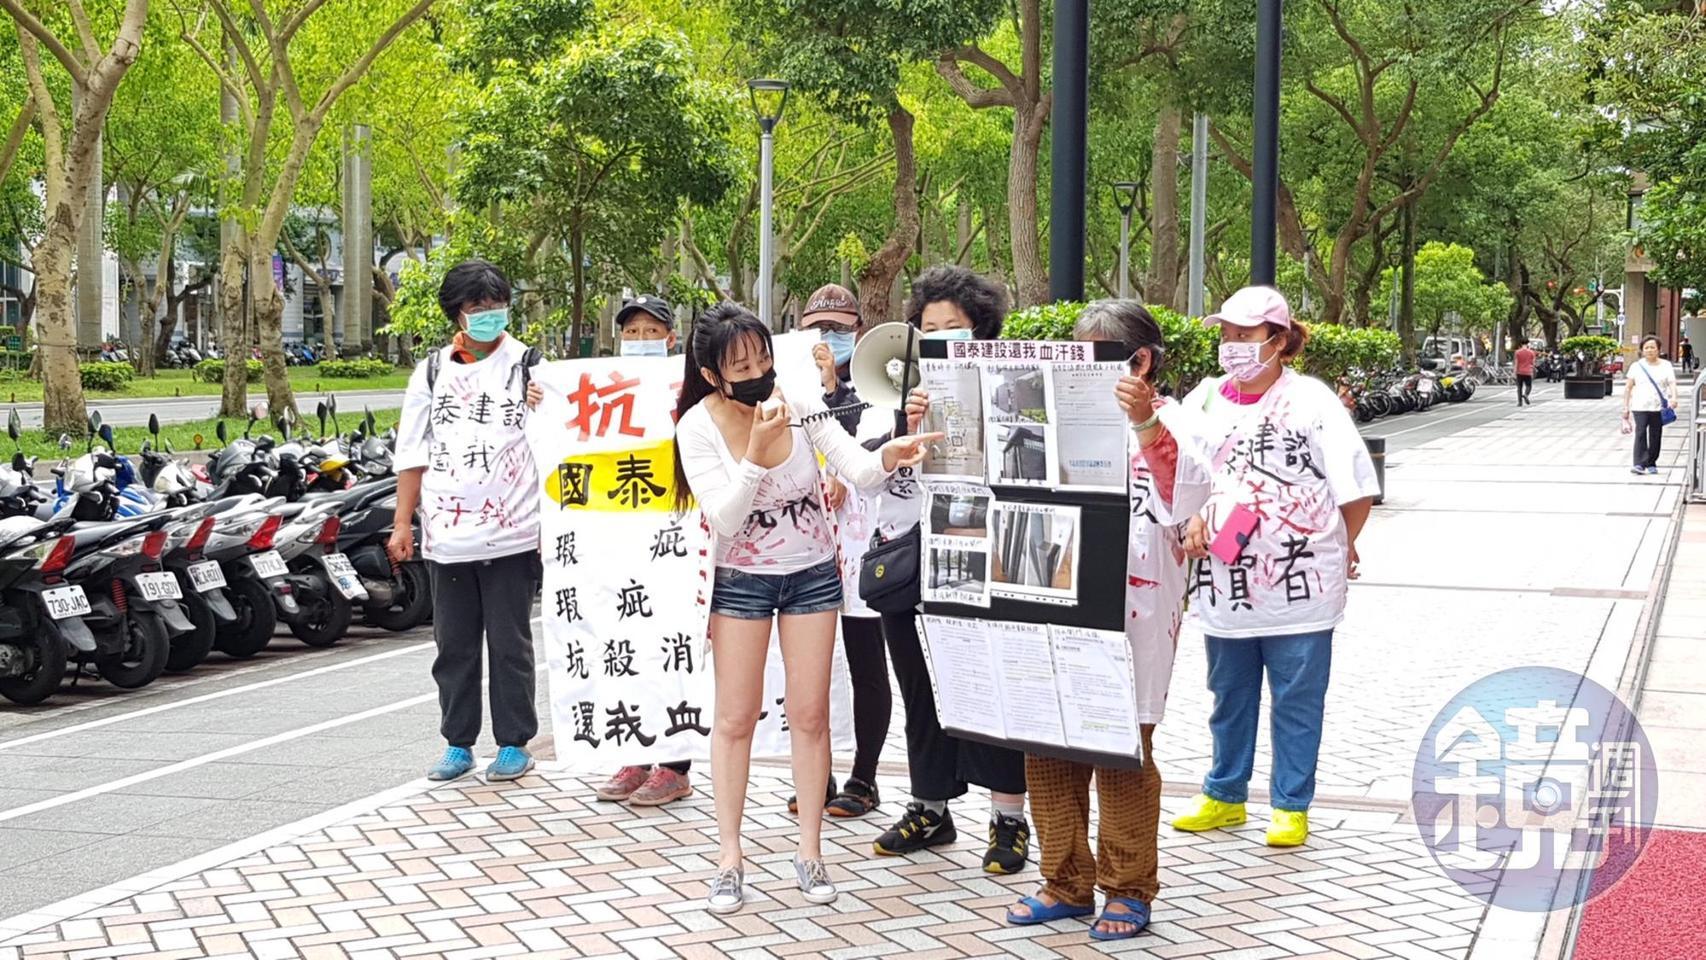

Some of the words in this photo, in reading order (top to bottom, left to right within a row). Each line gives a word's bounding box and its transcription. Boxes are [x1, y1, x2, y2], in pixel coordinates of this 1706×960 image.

[953, 341, 1086, 361] 國泰建設還我血汗錢
[433, 392, 526, 430] 泰建設
[565, 370, 686, 442] 抗
[558, 453, 667, 510] 國泰
[47, 594, 89, 615] 730-JAC
